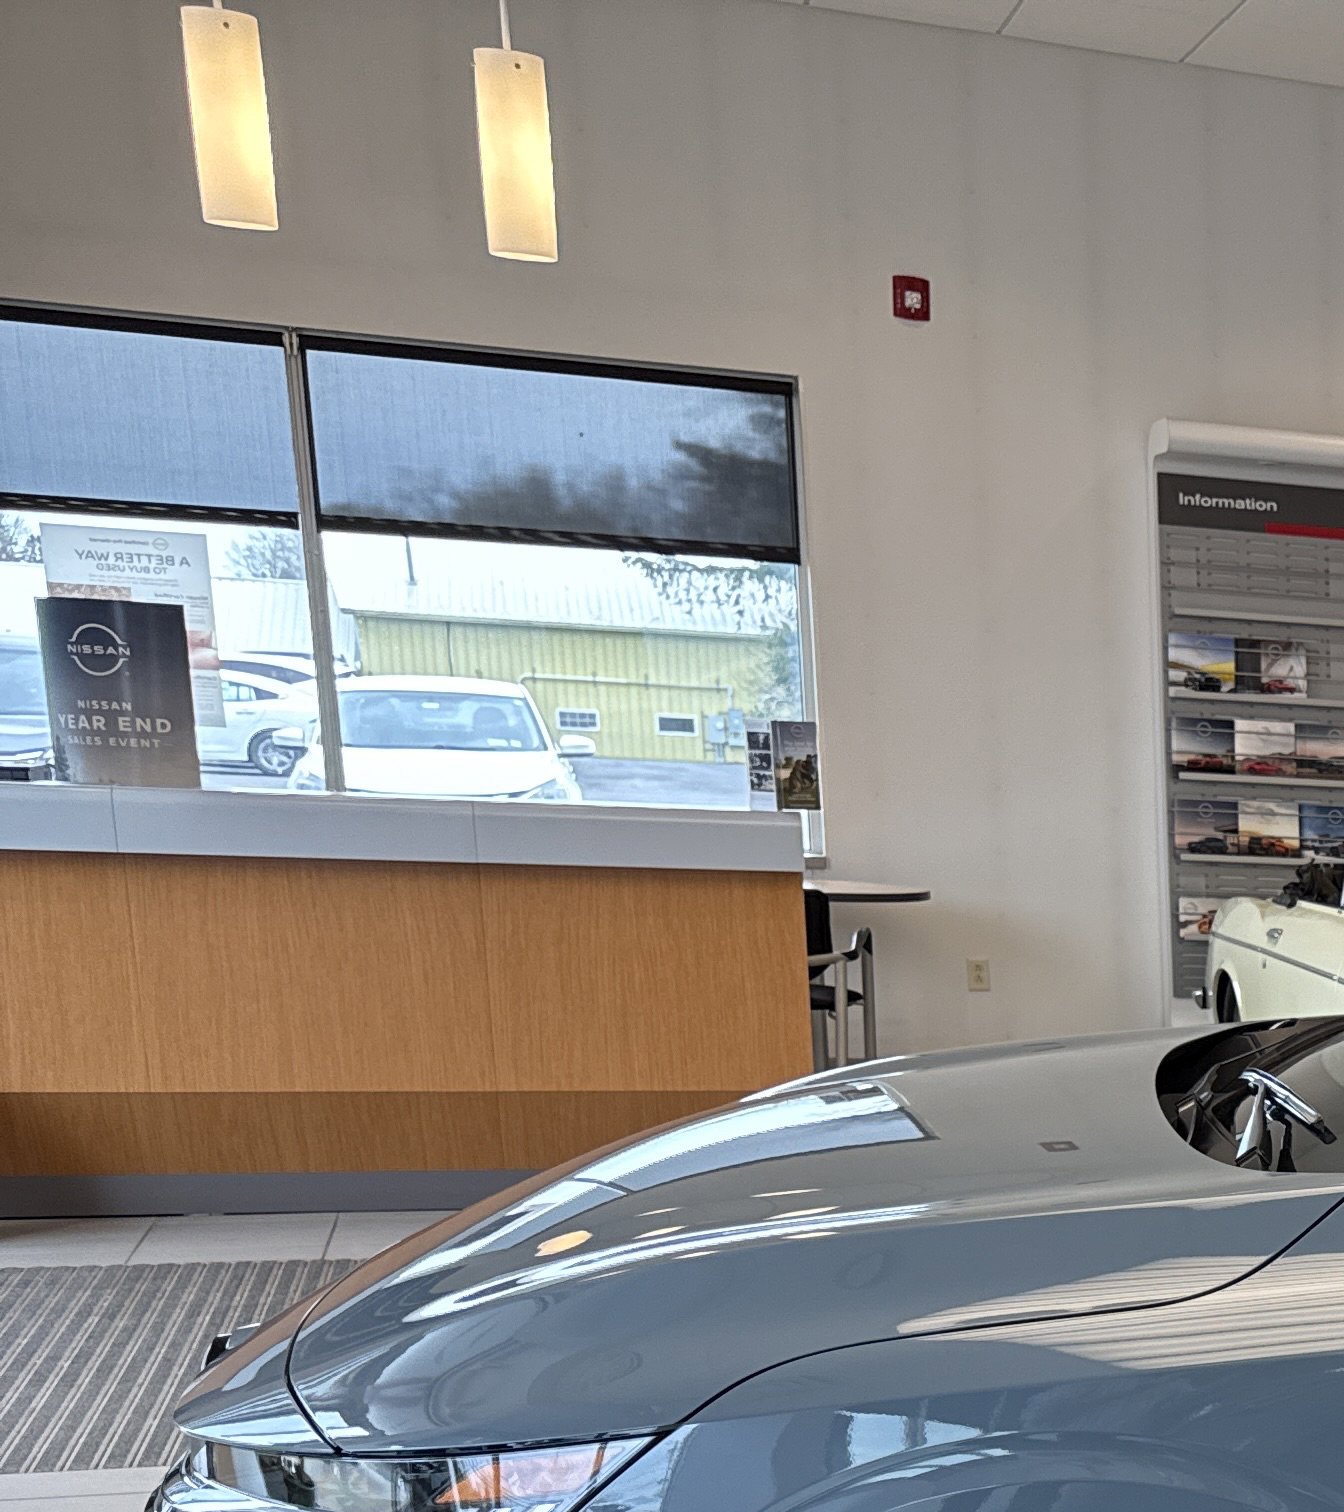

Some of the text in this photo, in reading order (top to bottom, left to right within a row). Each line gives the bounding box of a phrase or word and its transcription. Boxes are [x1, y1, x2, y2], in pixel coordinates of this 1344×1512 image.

[1178, 492, 1278, 512] Information
[66, 643, 131, 656] NISSAN
[78, 699, 132, 712] NISSAN
[57, 713, 172, 733] YEAR END
[67, 735, 161, 748] SALES EVENT
